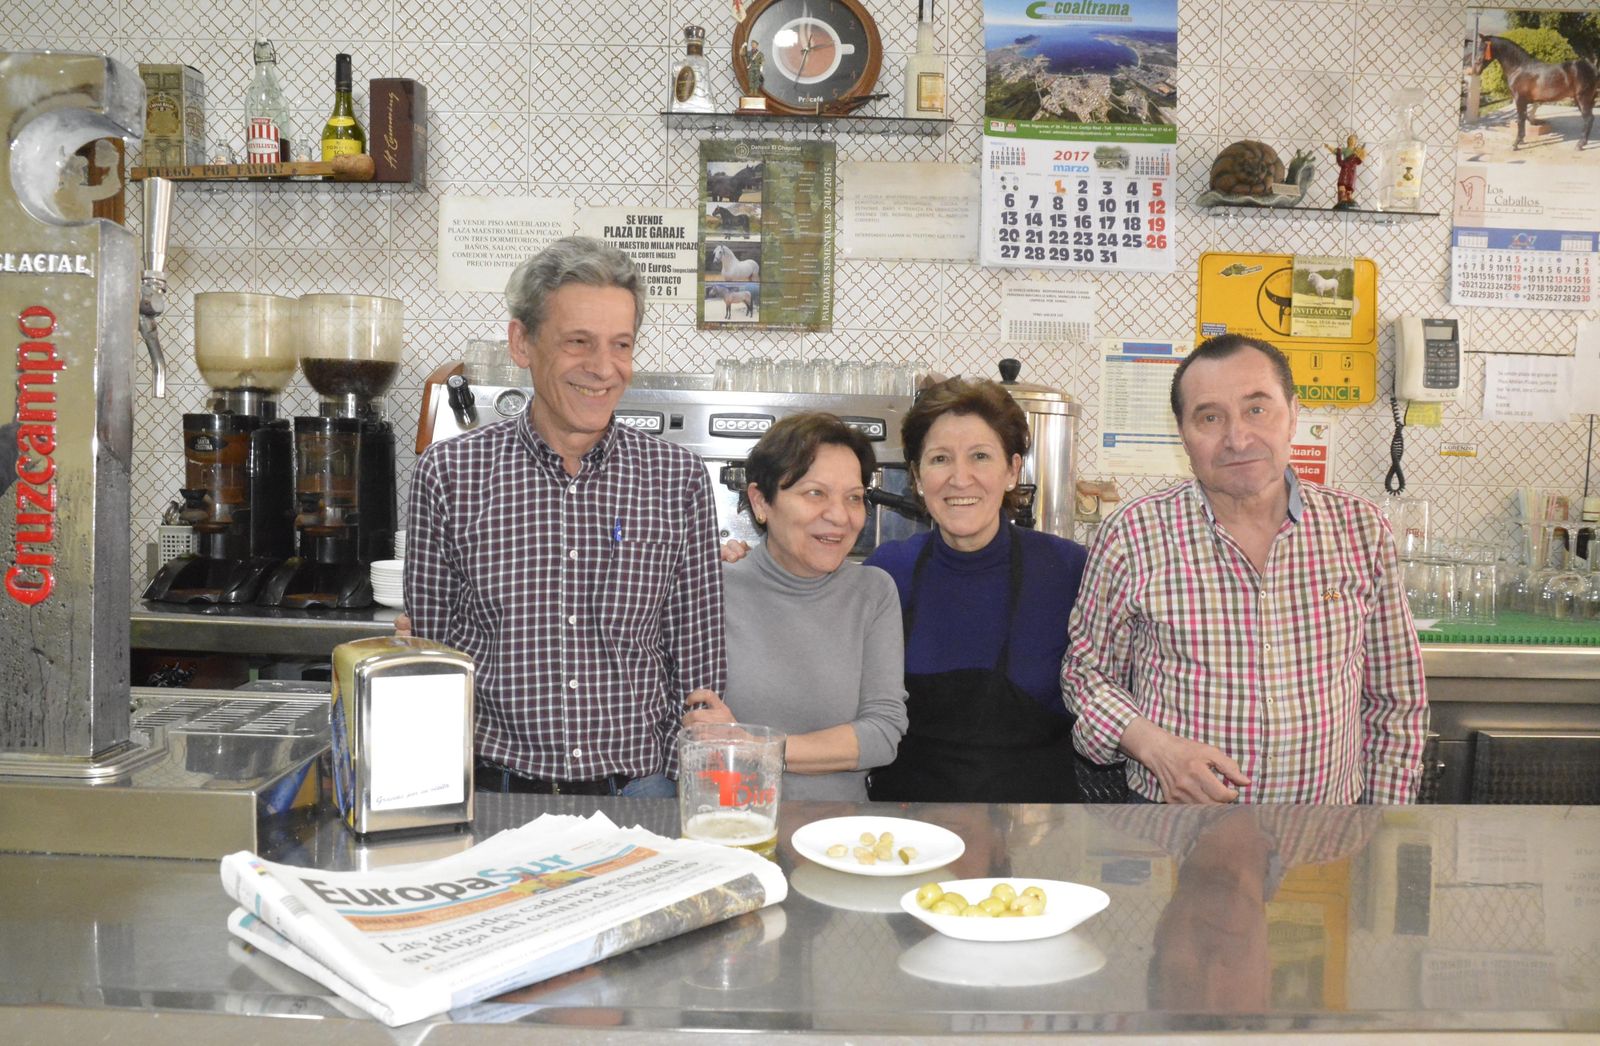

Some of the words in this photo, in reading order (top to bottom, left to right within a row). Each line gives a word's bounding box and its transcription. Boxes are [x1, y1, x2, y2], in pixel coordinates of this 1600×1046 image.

[1054, 1, 1130, 16] coaltrama
[1053, 150, 1090, 162] 2017
[203, 165, 230, 176] POR
[1053, 164, 1090, 173] marzo
[824, 167, 832, 211] 2014/2015
[1078, 180, 1088, 194] 2
[1102, 181, 1113, 195] 3
[1127, 182, 1138, 196] 4
[1152, 183, 1162, 197] 5
[1005, 193, 1015, 208] 6
[1029, 195, 1039, 209] 7
[1052, 196, 1064, 211] 8
[1078, 197, 1088, 211] 9
[1098, 199, 1116, 212] 10
[1125, 200, 1139, 213] 11
[1148, 200, 1166, 214] 12
[1494, 195, 1541, 206] Caballos
[626, 215, 636, 224] SE
[638, 215, 663, 225] VENDE
[1001, 212, 1018, 226] 13
[1025, 213, 1043, 226] 14
[1050, 214, 1067, 228] 15
[1074, 215, 1092, 229] 16
[1099, 216, 1116, 230] 17
[1123, 217, 1141, 231] 18
[1148, 217, 1166, 232] 19
[604, 226, 633, 238] PLAZA
[635, 226, 648, 238] DE
[649, 226, 685, 239] GARAJE
[999, 228, 1020, 242] 20
[1026, 230, 1043, 243] 21
[1049, 231, 1069, 245] 22
[1073, 232, 1093, 246] 23
[1097, 233, 1118, 247] 24
[1122, 234, 1142, 248] 25
[1146, 235, 1167, 249] 26
[619, 241, 649, 250] MAESTRO
[650, 241, 674, 250] MILLAN
[823, 214, 832, 272] SEMENTALES
[1001, 245, 1020, 259] 27
[1025, 246, 1045, 260] 28
[1049, 247, 1070, 261] 29
[1073, 249, 1094, 263] 30
[1100, 250, 1117, 263] 31
[648, 263, 672, 273] Euros
[647, 276, 681, 284] CONTACTO
[823, 272, 831, 285] DE
[821, 286, 830, 321] PARADA
[1308, 386, 1360, 400] ONCE
[4, 304, 67, 606] Cruzcampo
[1290, 448, 1322, 457] tuario
[1295, 465, 1320, 474] ásica
[428, 911, 520, 945] grandes
[402, 950, 437, 964] su
[431, 933, 490, 953] fuga
[490, 920, 527, 935] del
